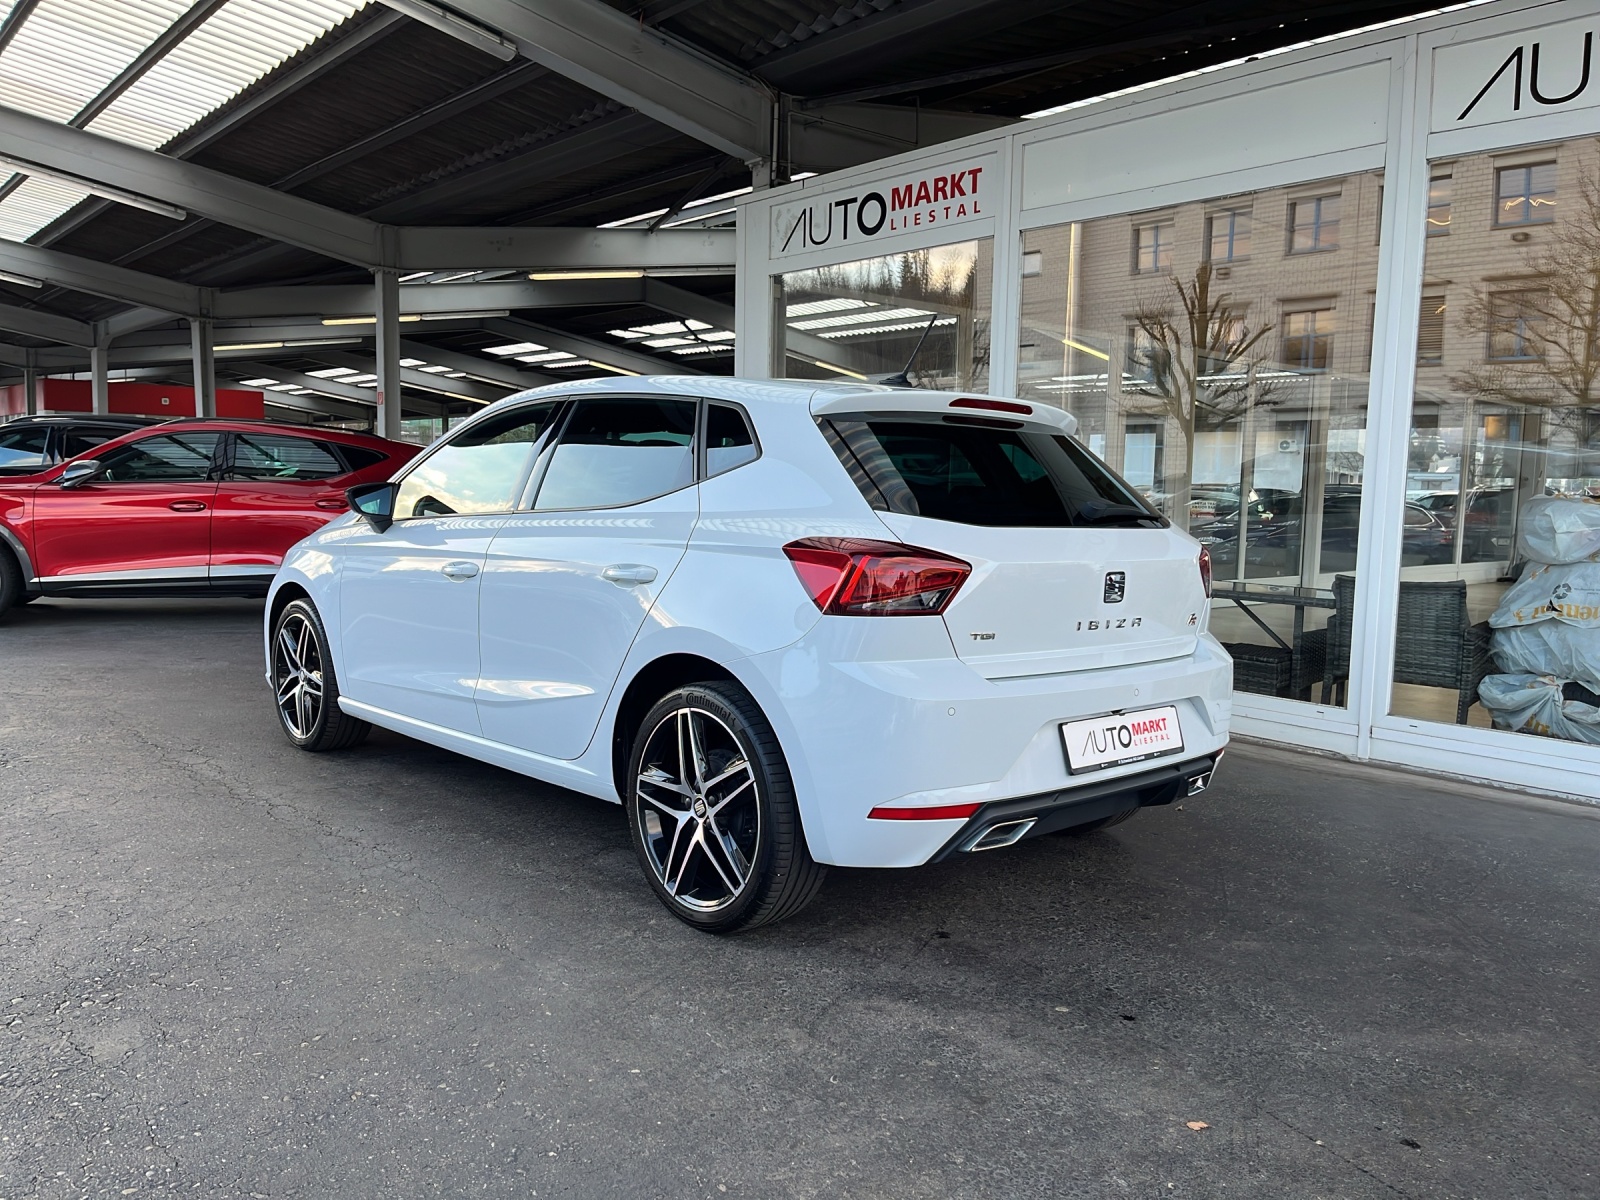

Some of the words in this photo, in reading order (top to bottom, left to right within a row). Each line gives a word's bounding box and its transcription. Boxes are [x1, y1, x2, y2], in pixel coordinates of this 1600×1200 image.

[1456, 31, 1600, 121] AU
[781, 192, 887, 252] AUTO
[890, 167, 983, 211] MARKT
[890, 201, 981, 230] LIESTAL
[970, 632, 996, 641] TGI
[1076, 617, 1142, 632] IBIZA
[686, 692, 731, 722] Continental
[1082, 724, 1132, 757] AUTO
[1131, 718, 1167, 737] MARKT
[1133, 733, 1170, 747] LIESTAL
